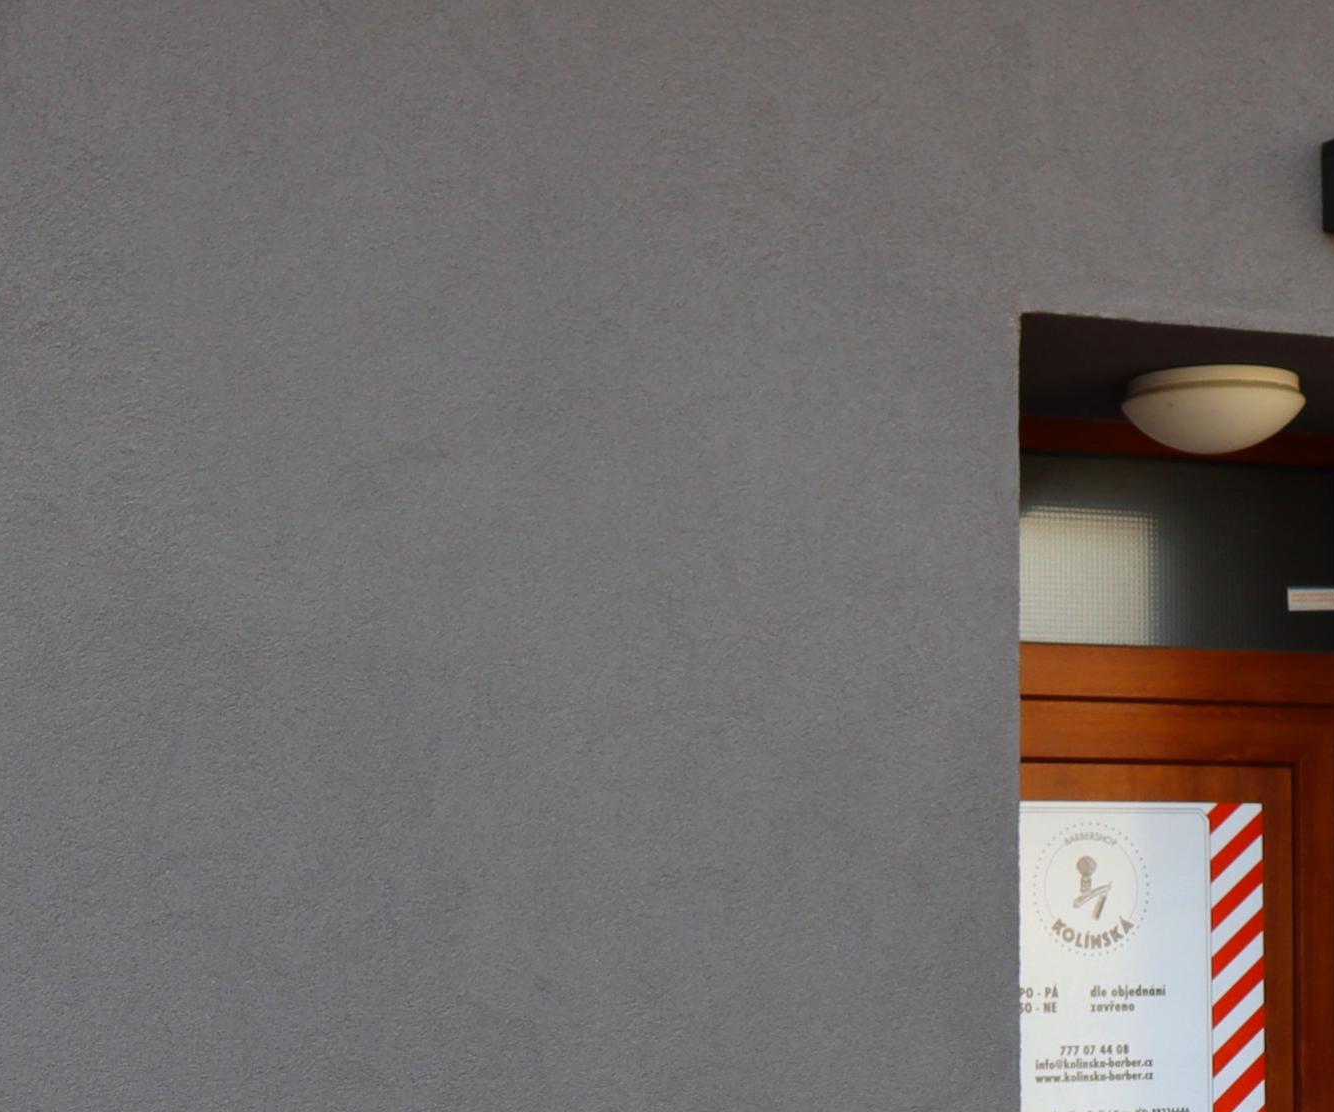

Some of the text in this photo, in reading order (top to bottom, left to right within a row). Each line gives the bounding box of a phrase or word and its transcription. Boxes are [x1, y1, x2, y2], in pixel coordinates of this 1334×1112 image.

[1064, 831, 1118, 846] BARBERSHOP
[1045, 984, 1059, 998] PÁ
[1090, 985, 1107, 997] dle
[1111, 984, 1166, 1000] objednání
[1043, 1002, 1057, 1013] NE
[1090, 1000, 1135, 1012] zavřeno
[1060, 1044, 1129, 1056] 777 07 44 08
[1035, 1057, 1153, 1070] info@kolinska-barber.cz
[1035, 1071, 1154, 1083] www.kolinska-barber.cz
